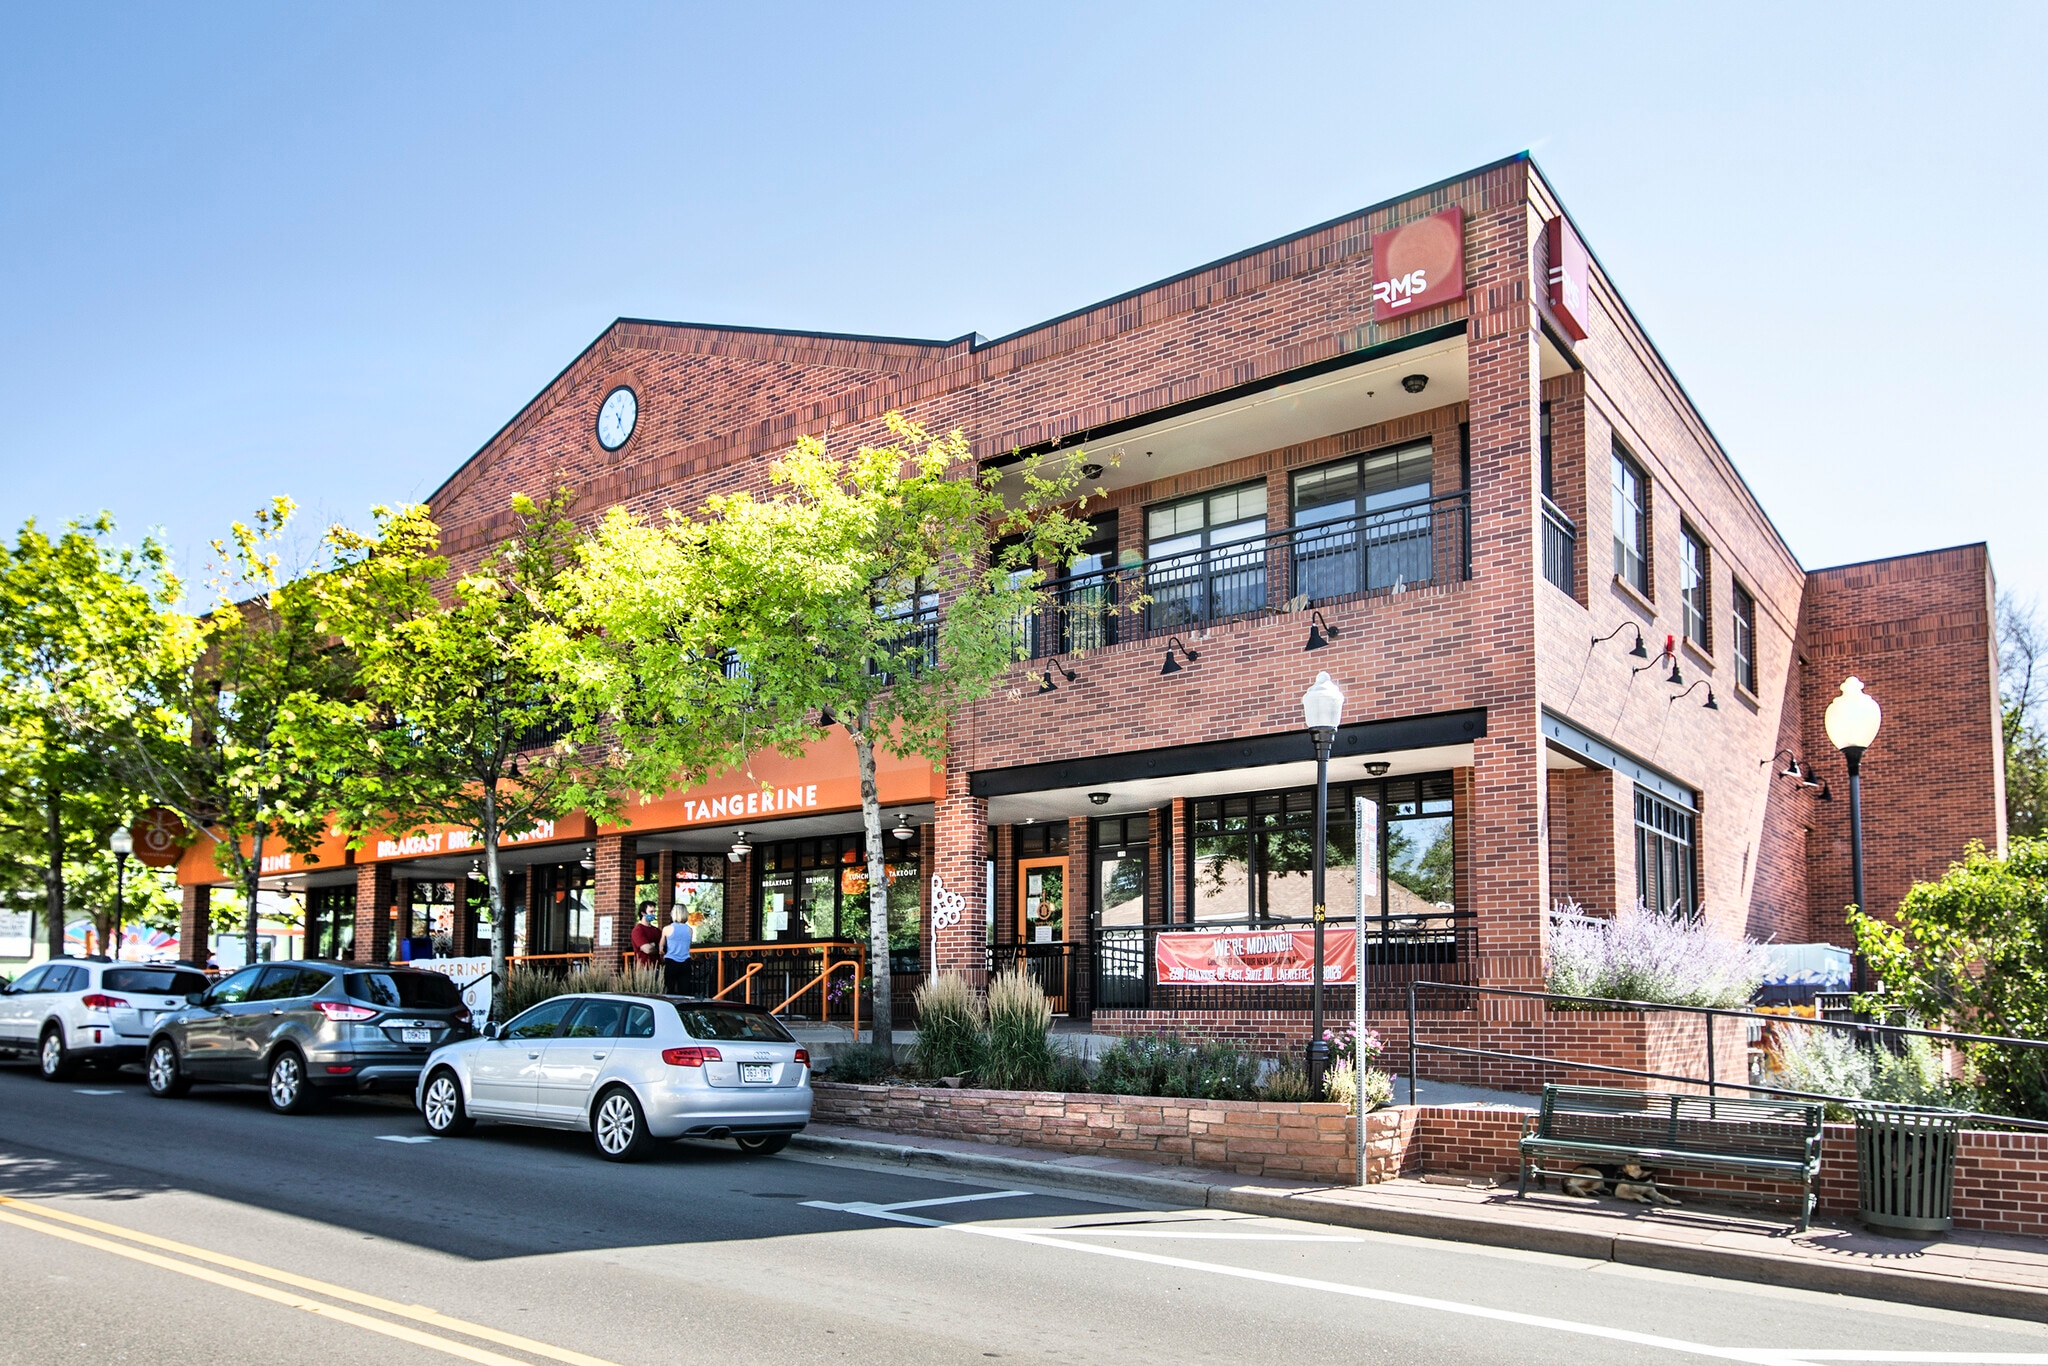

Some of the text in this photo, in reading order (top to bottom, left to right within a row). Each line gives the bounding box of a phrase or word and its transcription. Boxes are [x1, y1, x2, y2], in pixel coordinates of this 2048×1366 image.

[1373, 269, 1427, 307] RMS
[684, 785, 817, 821] TANGERINE
[377, 833, 442, 858] BREAKFAST
[805, 876, 829, 884] BRUNCH
[849, 873, 869, 881] LUNCH
[889, 869, 917, 877] TAKEOUT
[762, 879, 792, 888] BREAKFAST
[1213, 933, 1294, 957] WE'RE MOVING!!
